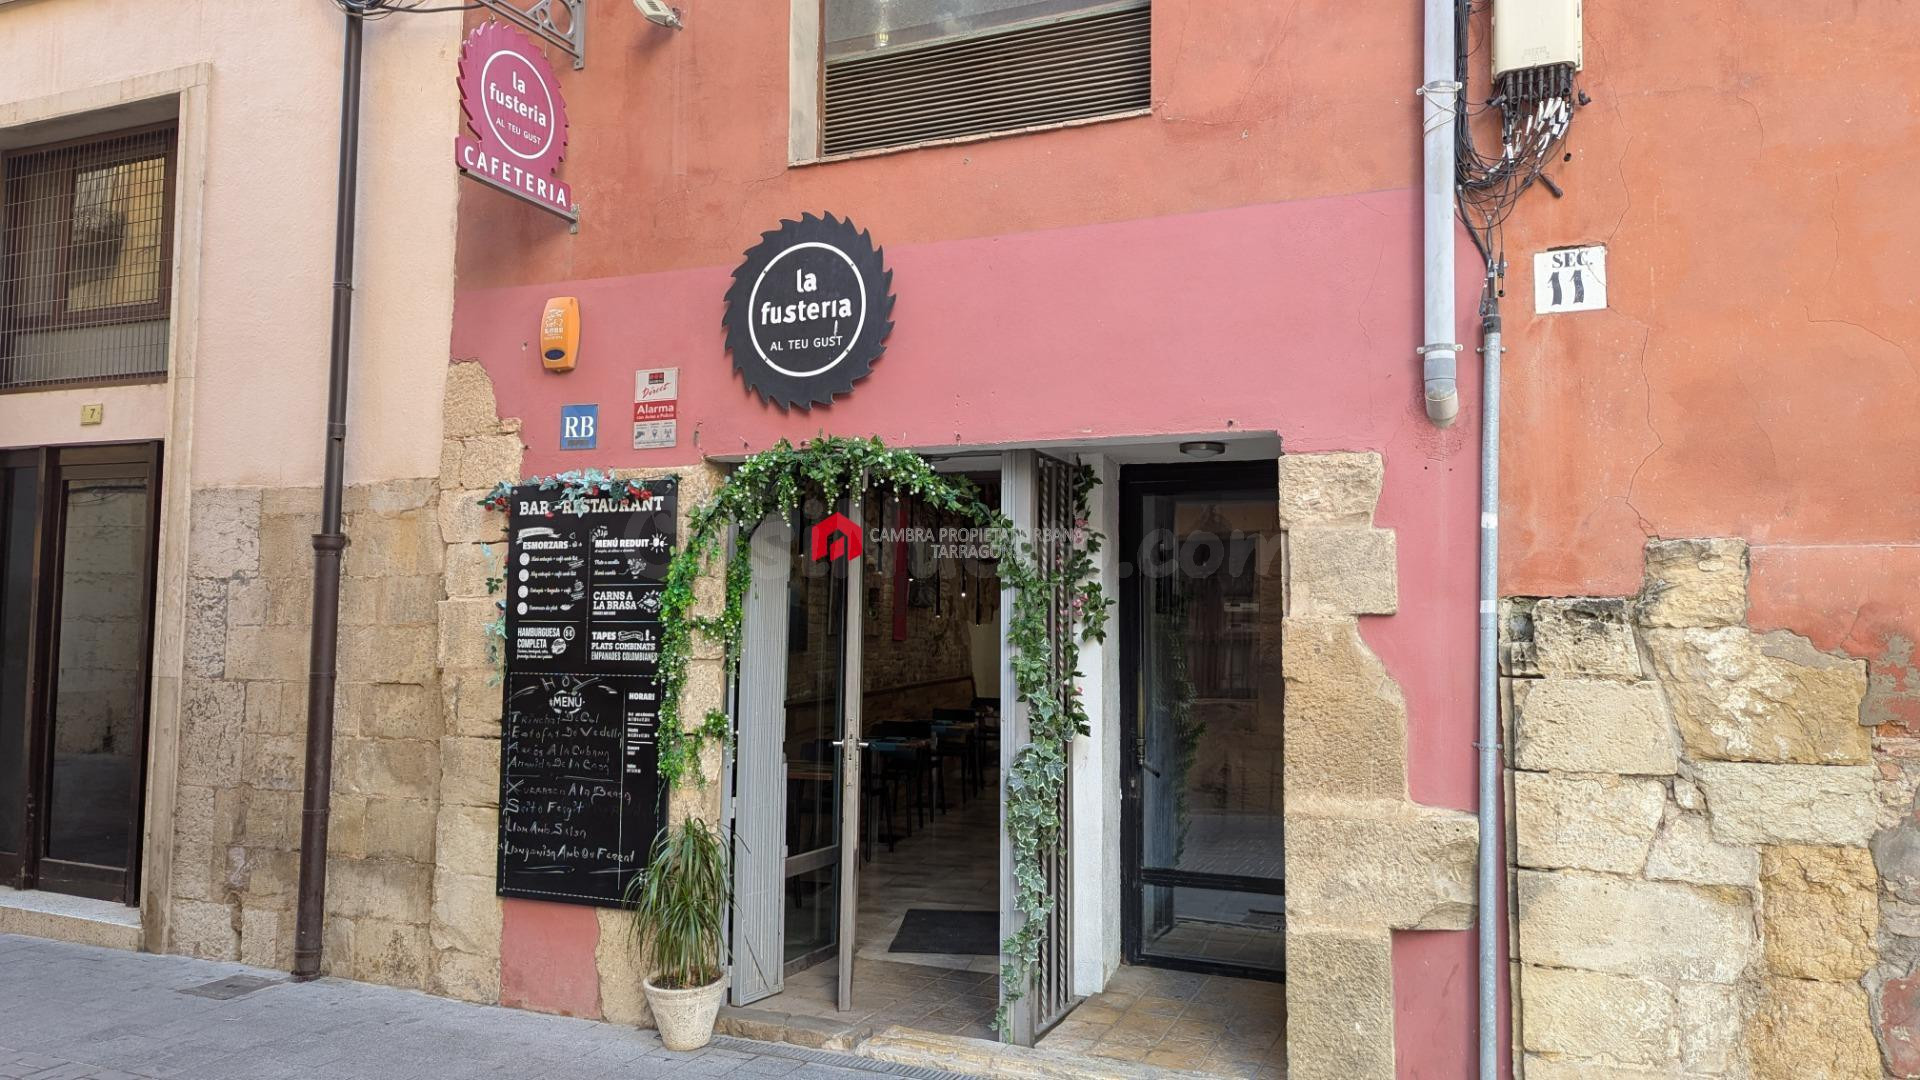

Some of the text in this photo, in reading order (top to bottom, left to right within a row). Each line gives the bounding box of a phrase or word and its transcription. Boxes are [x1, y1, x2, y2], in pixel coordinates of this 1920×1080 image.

[513, 71, 526, 94] la
[489, 82, 547, 127] fusteria
[496, 117, 541, 145] AL TEU GUST
[464, 146, 567, 207] CAFETERIA
[796, 268, 817, 293] la
[1547, 270, 1584, 306] 11
[761, 298, 852, 326] fusteria
[770, 335, 843, 351] AL TEU GUST
[90, 408, 96, 419] 7
[637, 404, 674, 415] Alarma
[564, 415, 594, 438] RB
[519, 501, 550, 515] BAR
[562, 496, 664, 514] RSTAURANT
[522, 541, 569, 550] ESMORZARS
[594, 537, 618, 548] MENÚ
[620, 539, 649, 548] REDUIT
[593, 591, 633, 600] CARNS A
[593, 601, 637, 610] LA BRASA
[517, 627, 560, 637] HAMBURGUESA
[592, 631, 616, 640] TAPES
[517, 638, 547, 648] COMPLETA
[591, 642, 656, 651] PLATS COMBINATS
[591, 651, 621, 661] EMPANADES
[541, 675, 599, 696] HOY
[553, 692, 582, 708] MENÚ
[628, 692, 655, 700] HORARI
